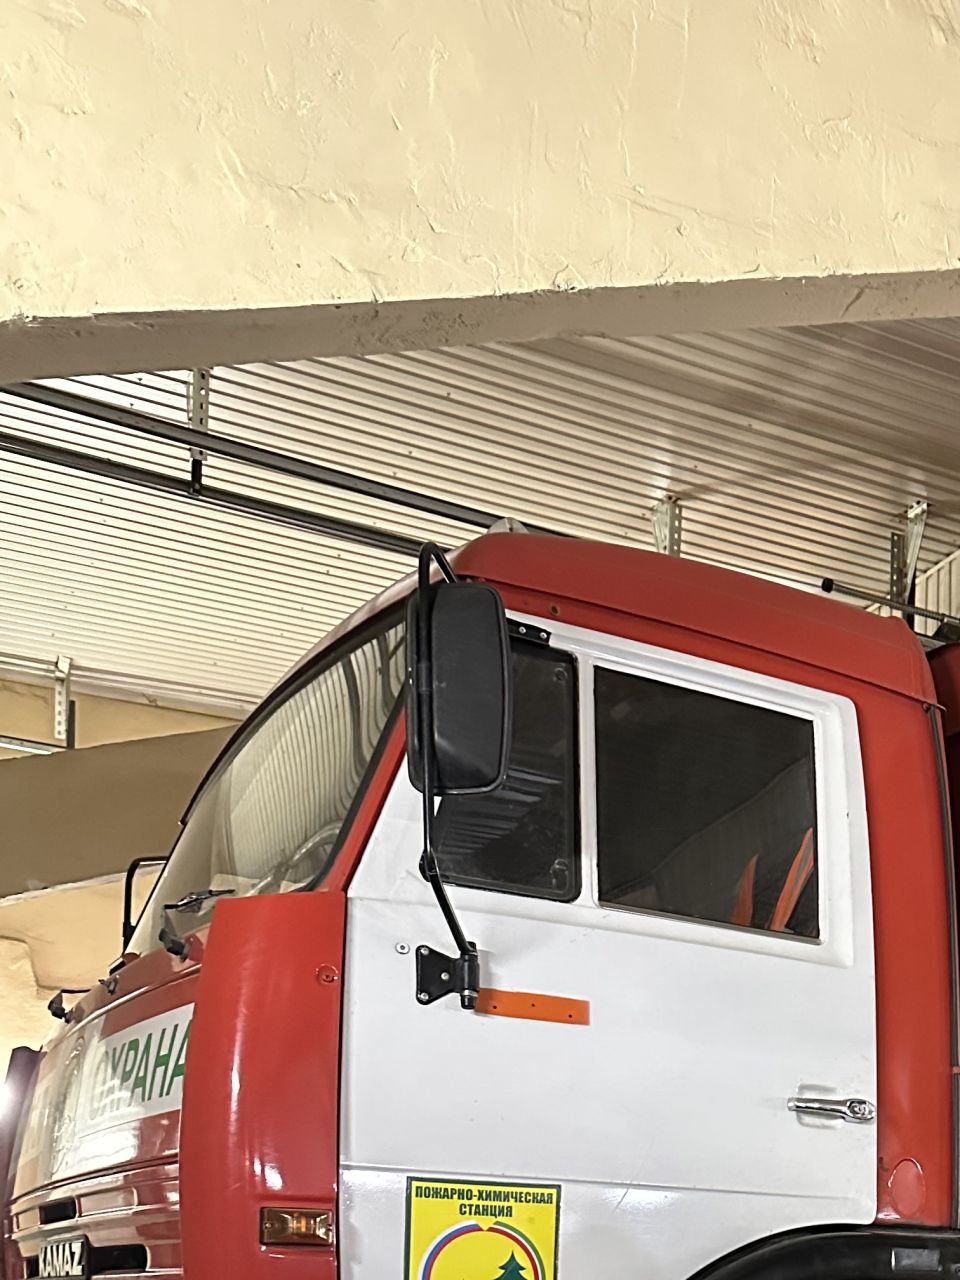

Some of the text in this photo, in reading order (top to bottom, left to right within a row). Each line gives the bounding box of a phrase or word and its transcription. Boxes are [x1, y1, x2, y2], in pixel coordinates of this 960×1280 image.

[415, 1185, 554, 1205] ПОЖАРНО-ХИМИЧЕСКАЯ
[458, 1203, 513, 1218] СТАНЦИЯ
[39, 1241, 83, 1278] KAMAZ
